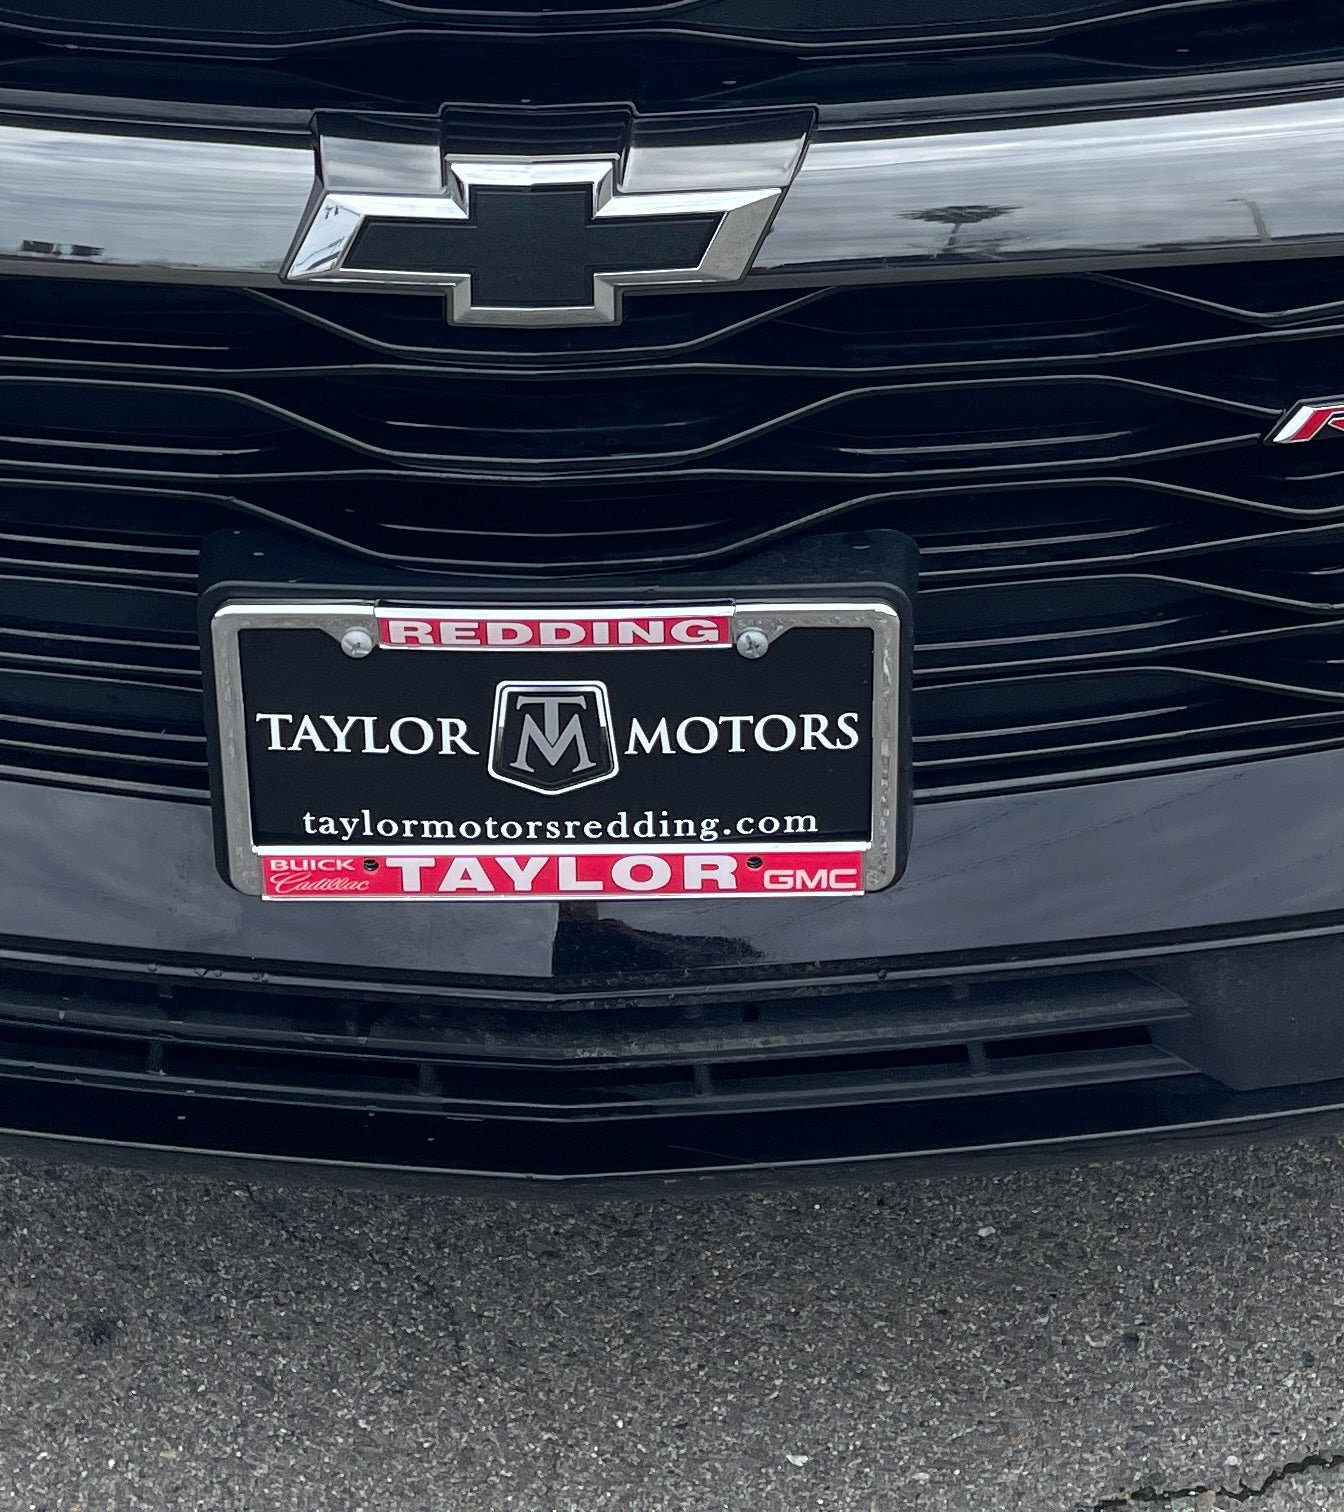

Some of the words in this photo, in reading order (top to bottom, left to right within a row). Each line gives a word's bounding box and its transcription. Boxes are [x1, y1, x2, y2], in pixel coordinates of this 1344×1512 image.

[388, 620, 719, 646] REDDING
[256, 713, 479, 756] TAYLOR
[624, 712, 859, 755] MOTORS
[302, 810, 818, 841] taylormotorsredding.com
[270, 859, 357, 872] BUICK
[386, 855, 738, 892] TAYLOR
[763, 867, 858, 890] GMC
[269, 873, 370, 894] Cadillac
